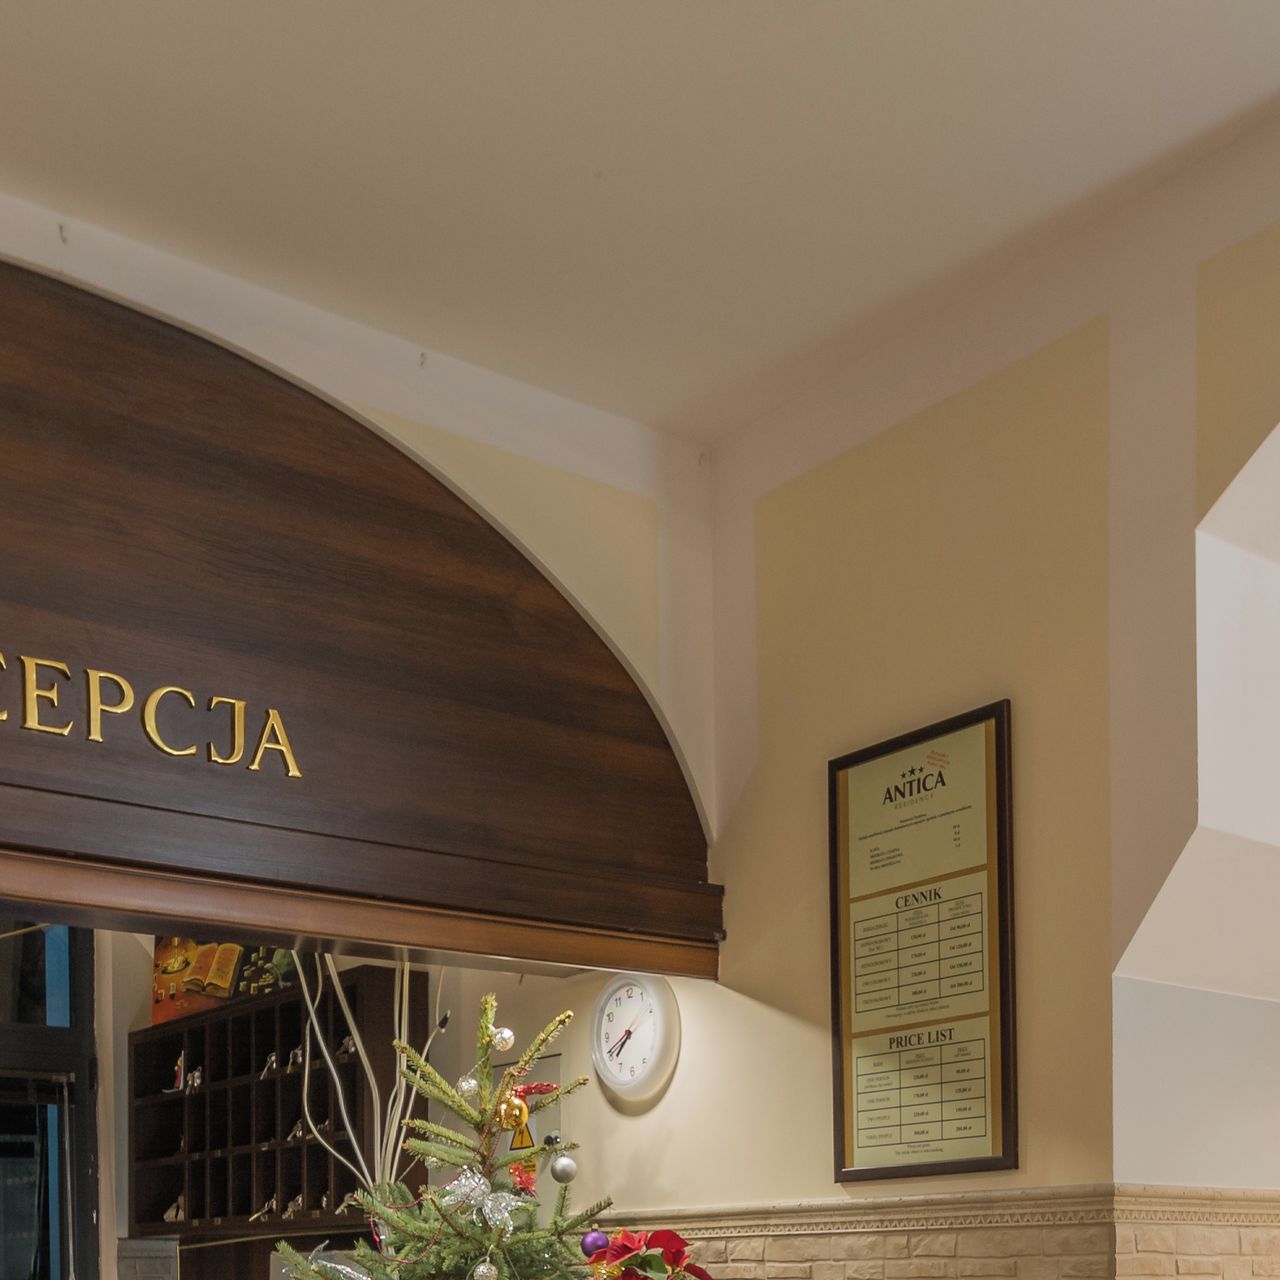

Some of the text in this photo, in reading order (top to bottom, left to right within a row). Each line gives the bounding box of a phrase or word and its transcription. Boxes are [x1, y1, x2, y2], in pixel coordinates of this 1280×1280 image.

[882, 770, 946, 805] ANTICA
[895, 887, 942, 909] CENNIK
[625, 987, 634, 999] 12
[614, 997, 622, 1008] 11
[606, 1011, 614, 1023] 10
[889, 1027, 955, 1049] PRICE LIST
